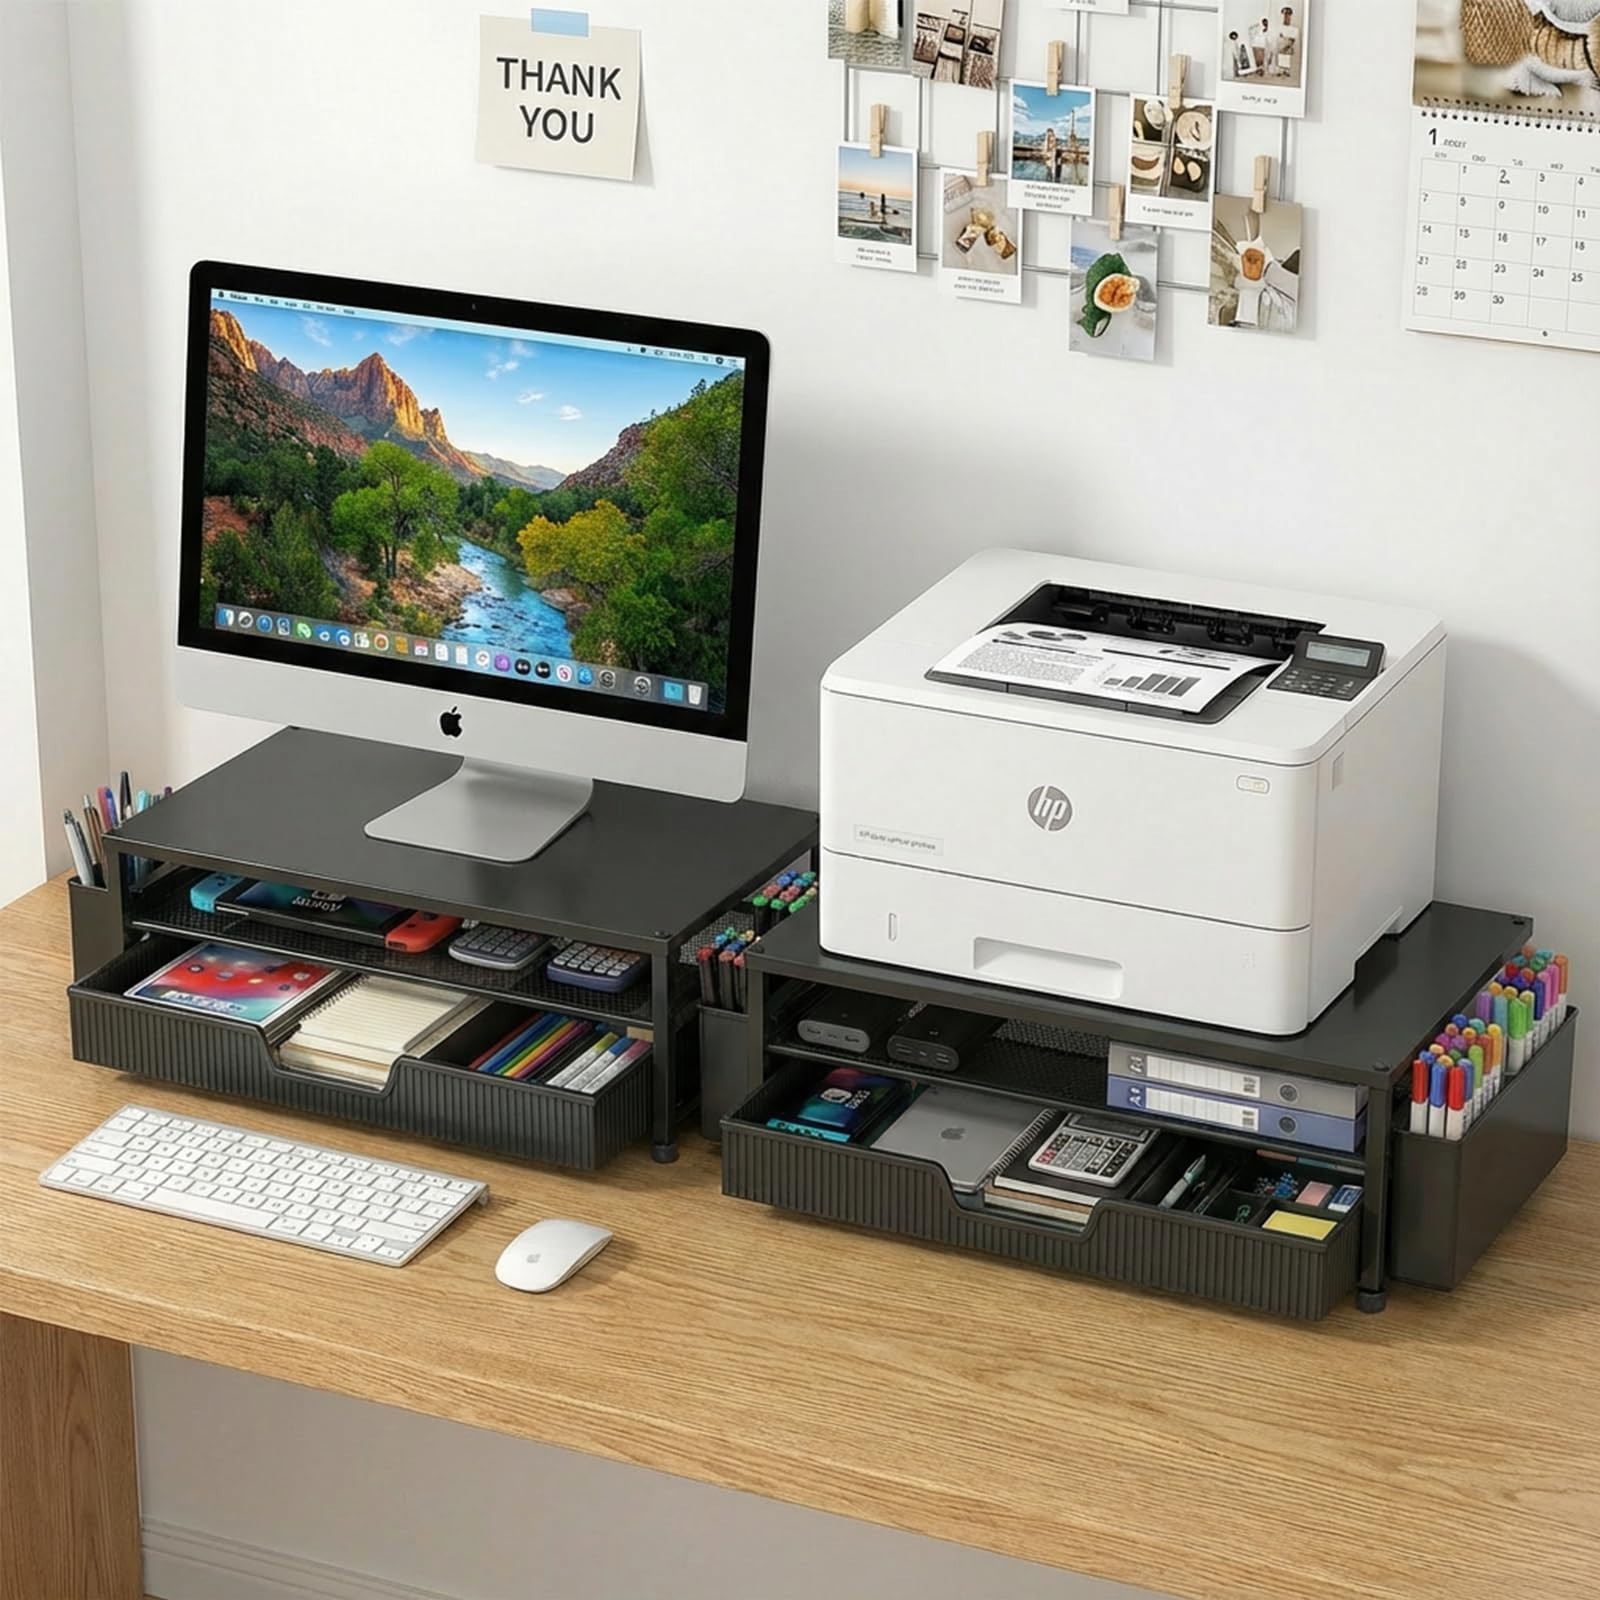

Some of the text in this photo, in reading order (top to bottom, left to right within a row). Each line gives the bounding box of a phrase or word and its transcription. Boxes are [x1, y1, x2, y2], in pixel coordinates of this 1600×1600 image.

[496, 56, 621, 101] THANK
[519, 104, 594, 144] YOU
[1428, 127, 1438, 146] 1
[1537, 205, 1549, 215] 10
[1577, 209, 1586, 219] 11
[1536, 237, 1547, 246] 17
[1571, 272, 1583, 282] 25
[1033, 785, 1067, 831] hp
